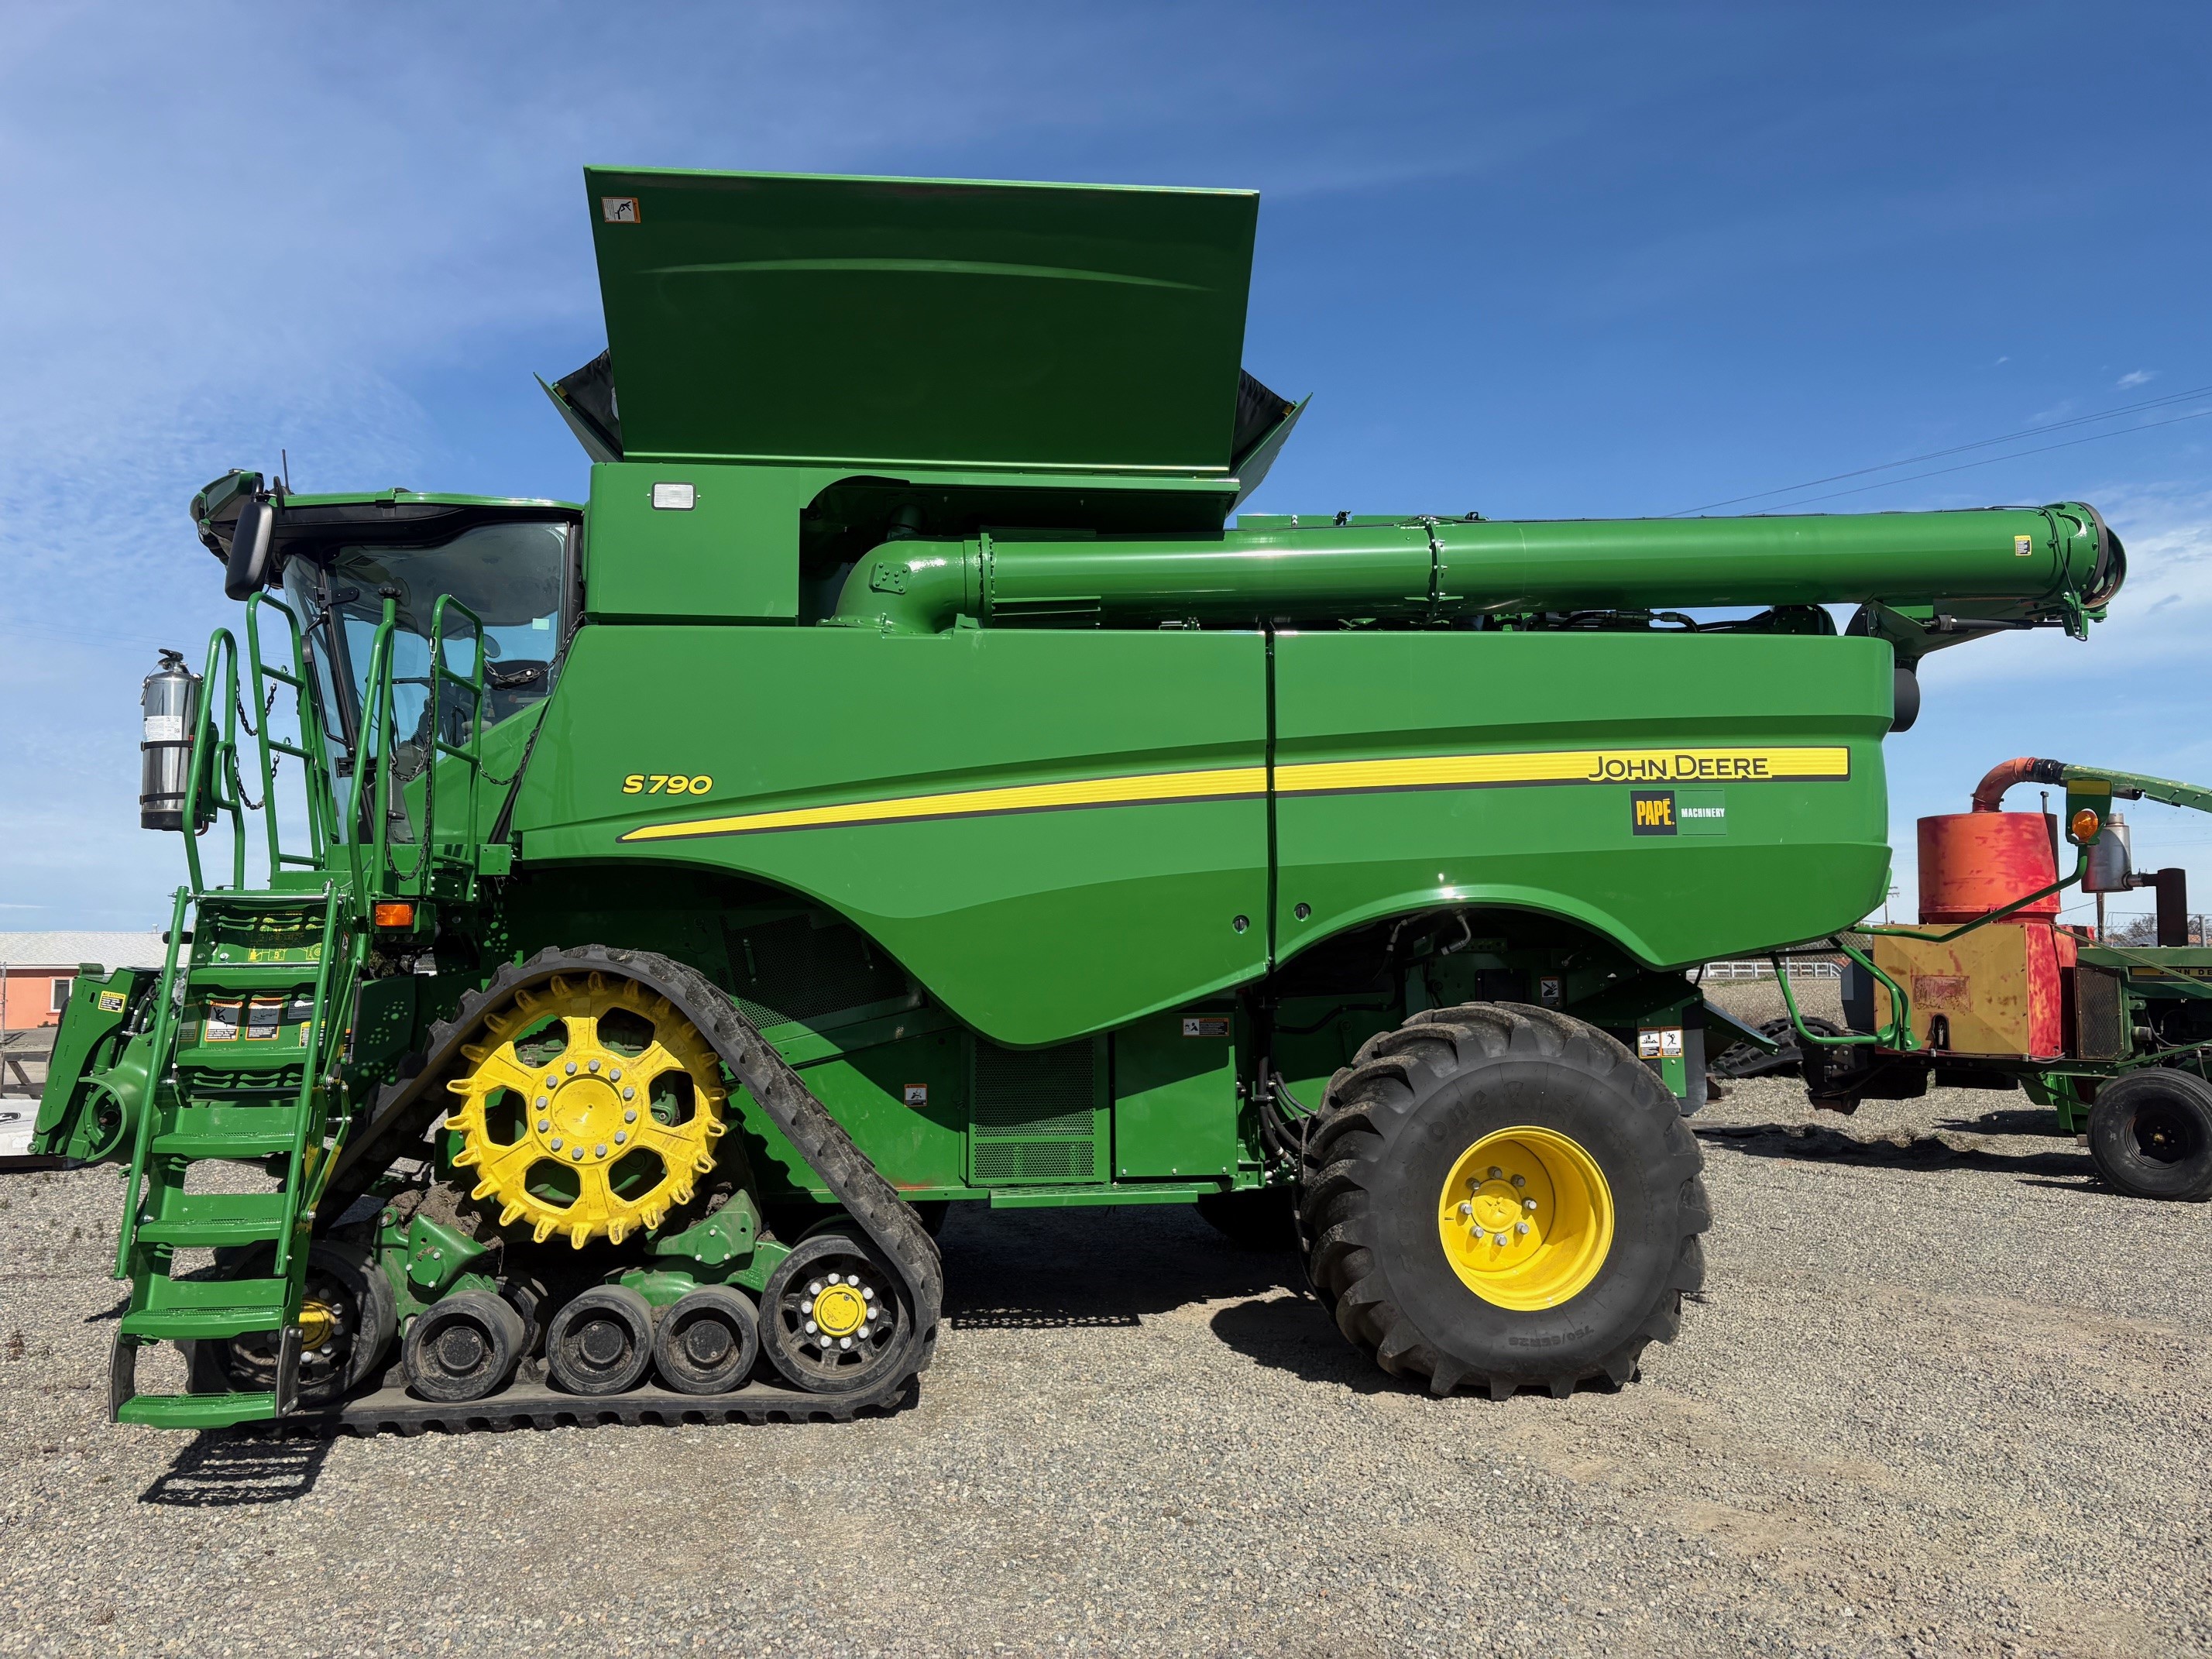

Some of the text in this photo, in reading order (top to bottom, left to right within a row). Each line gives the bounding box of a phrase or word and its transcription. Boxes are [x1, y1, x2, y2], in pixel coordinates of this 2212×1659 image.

[1589, 754, 1768, 777] JOHN DEERE
[621, 773, 713, 795] S790
[1681, 807, 1725, 818] MACHINERY
